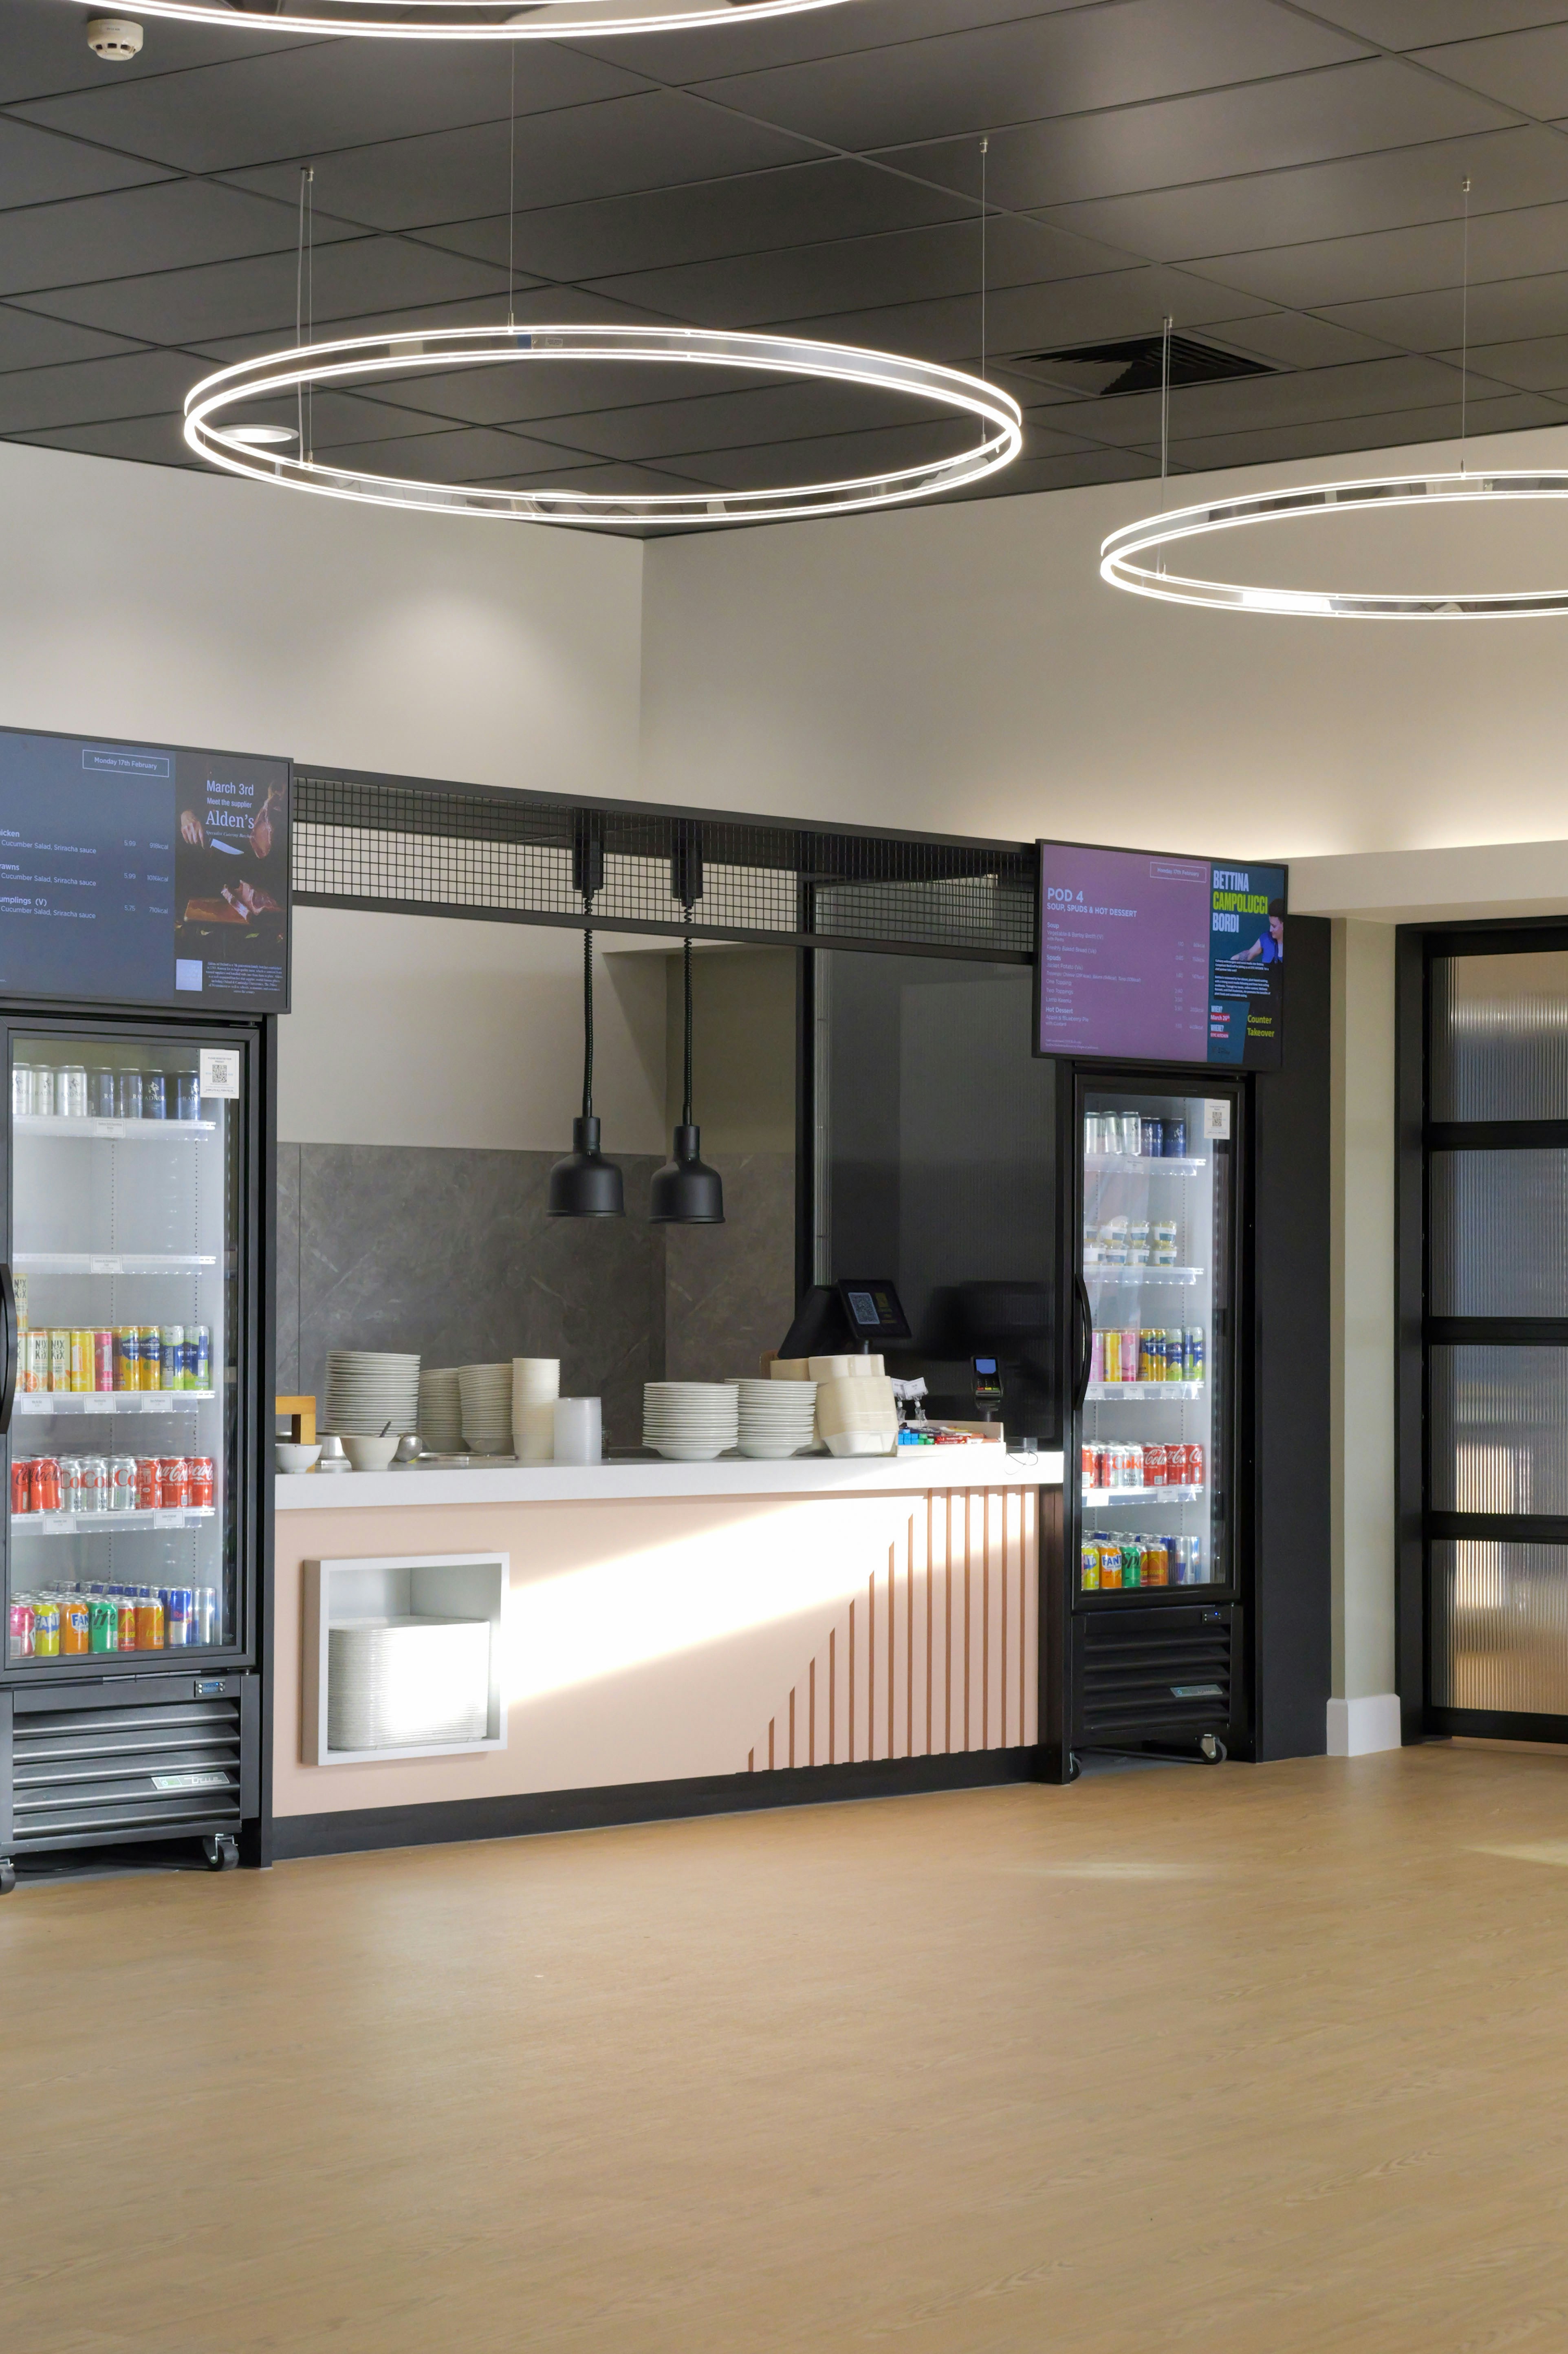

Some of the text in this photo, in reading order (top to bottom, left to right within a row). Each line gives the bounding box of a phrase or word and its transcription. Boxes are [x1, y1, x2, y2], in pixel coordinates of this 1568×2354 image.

[95, 757, 117, 766] Monday
[132, 761, 157, 770] February
[207, 780, 254, 796] March 3rd
[205, 810, 254, 829] Alden's
[1, 840, 32, 848] Cucumber
[1, 873, 32, 881] Cucumber
[1213, 870, 1249, 892] BETTINA
[35, 898, 47, 906] (V)
[1047, 887, 1084, 903] POD 4
[1213, 891, 1268, 914] CAMPOLUCCI
[1047, 902, 1065, 912] SOUP,
[1067, 905, 1088, 913] SPUDS
[1110, 908, 1137, 917] DESSERT
[1213, 913, 1239, 933] BORDI
[1247, 1015, 1272, 1024] Counter
[1247, 1028, 1275, 1037] Takeover
